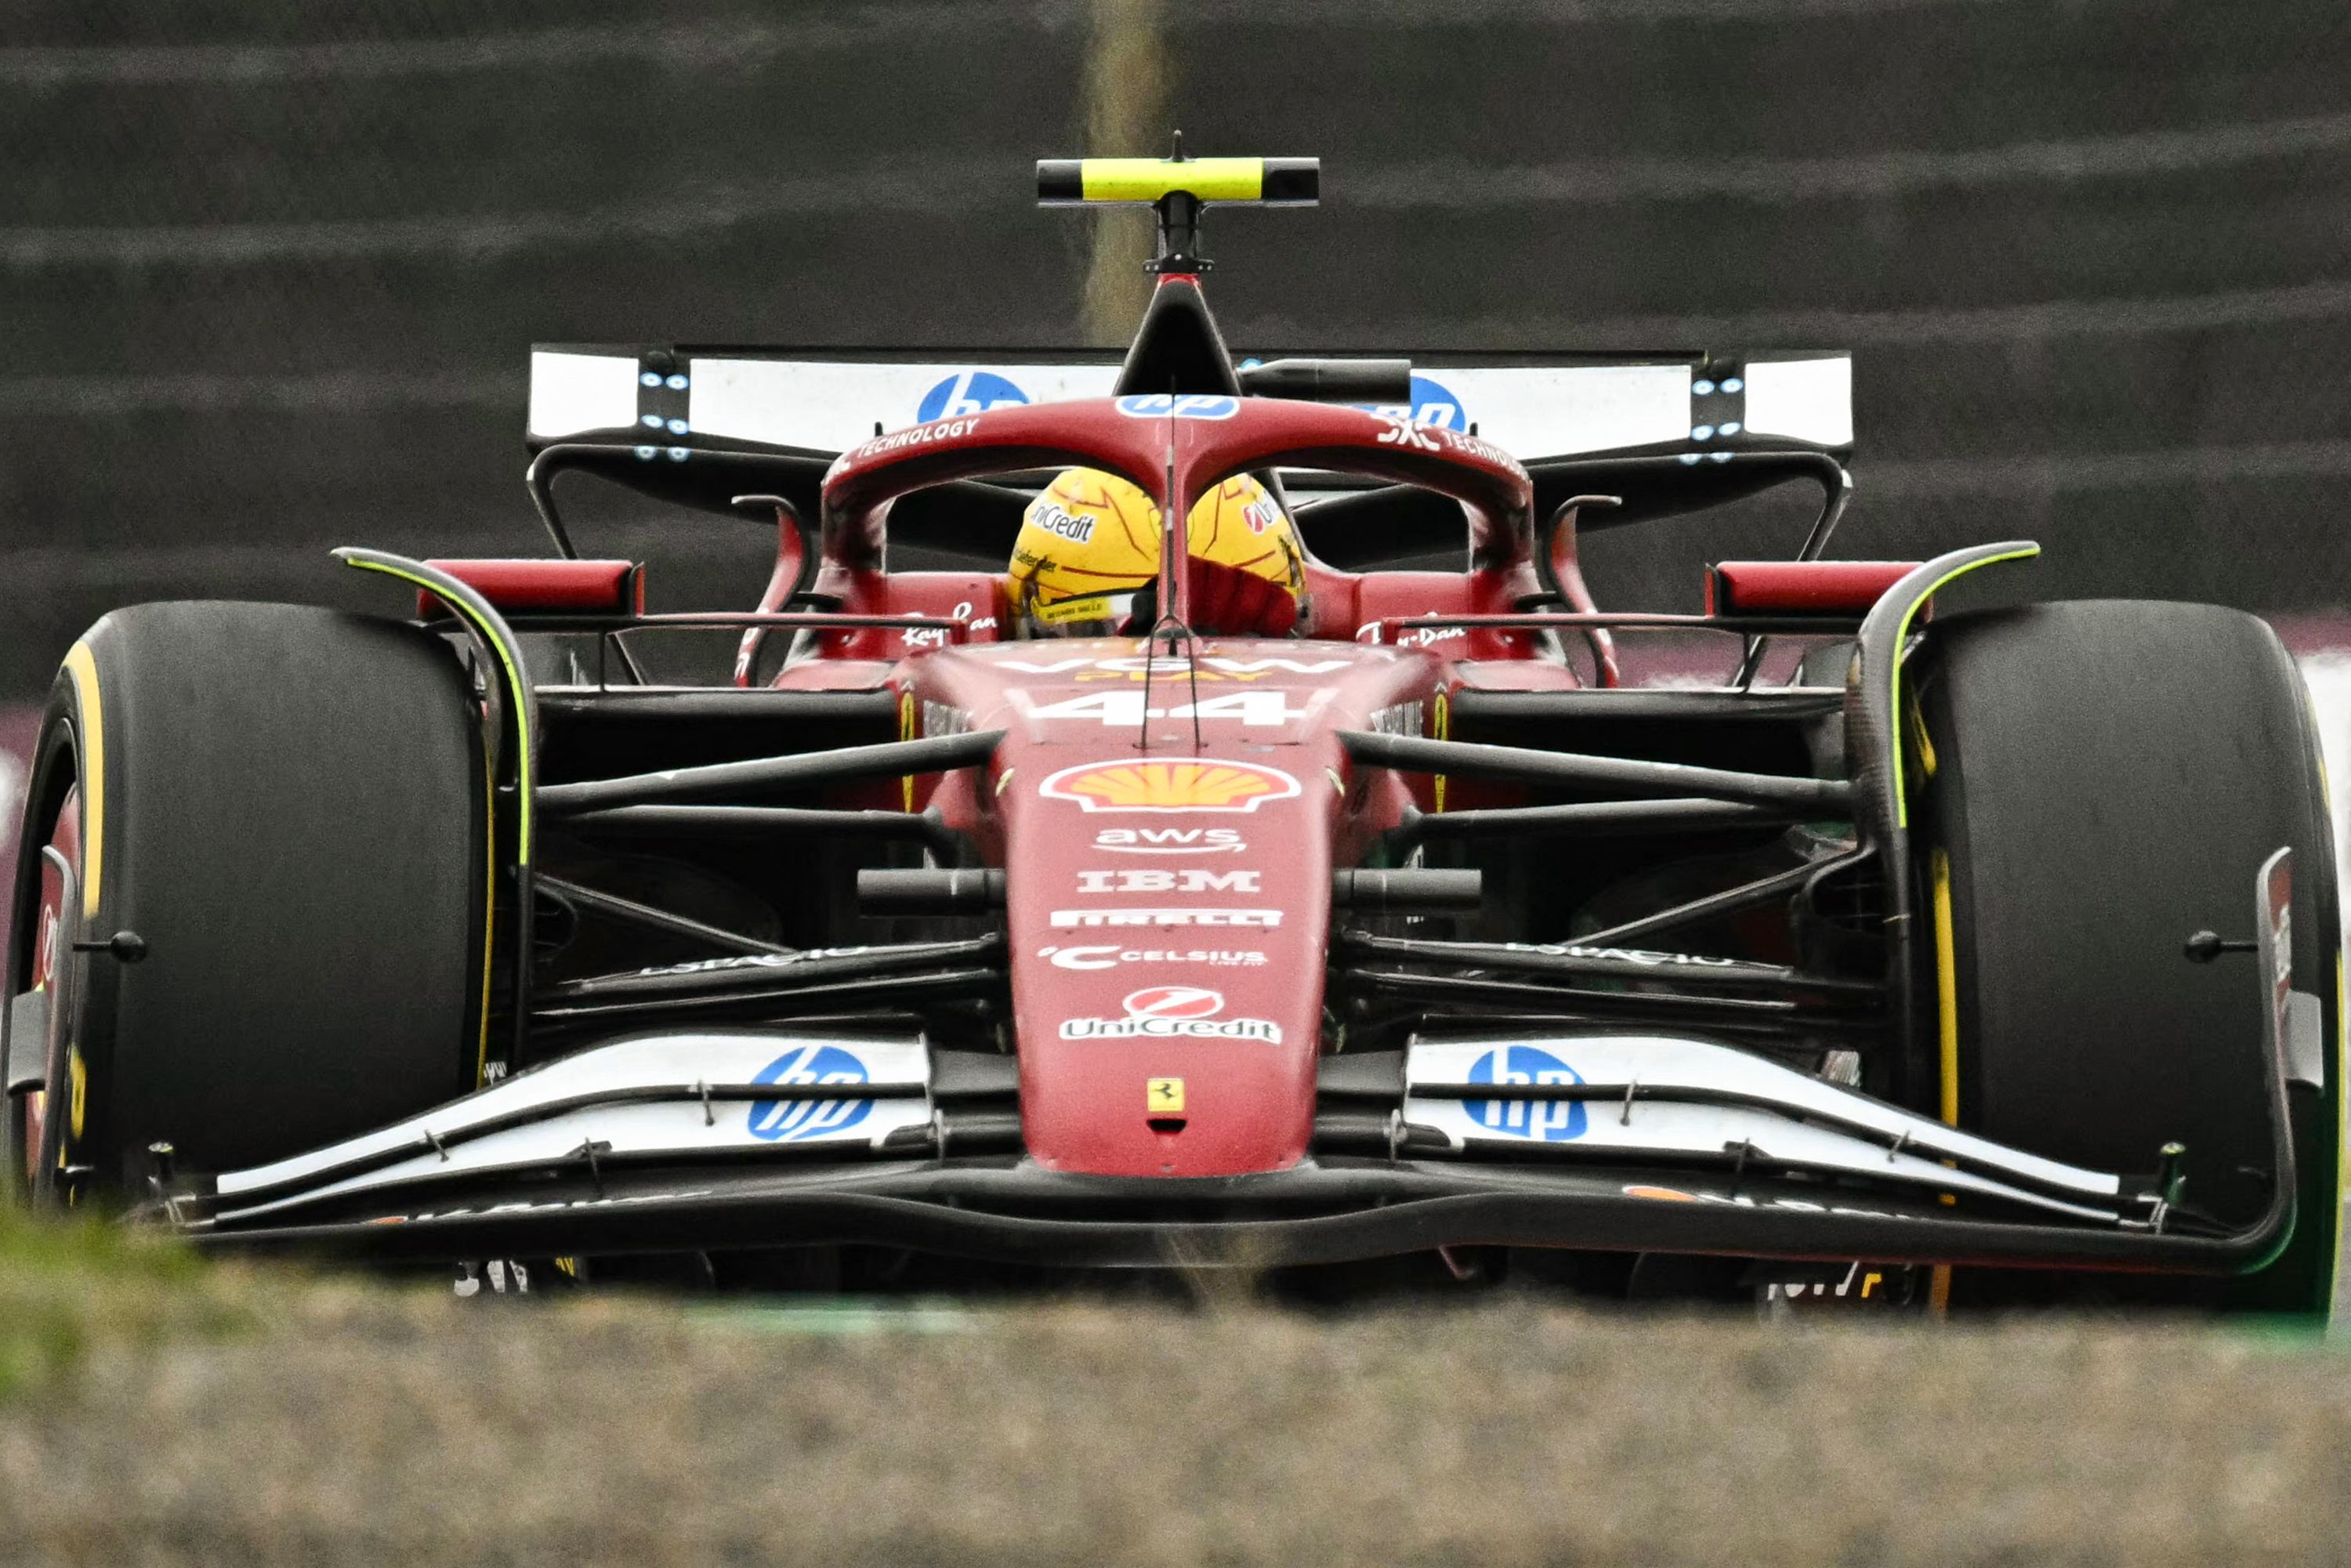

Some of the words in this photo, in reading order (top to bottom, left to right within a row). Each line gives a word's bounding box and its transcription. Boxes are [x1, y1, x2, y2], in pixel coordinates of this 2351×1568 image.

[857, 418, 979, 459] TECHNOLOGY
[1031, 505, 1095, 542] niCredit
[994, 657, 1353, 675] VGW
[1074, 670, 1272, 683] PLAY
[1026, 690, 1307, 726] 44
[1096, 827, 1243, 844] aws
[1076, 869, 1261, 893] IBM
[1119, 950, 1269, 962] CELSIUS
[1065, 1018, 1278, 1040] UniCredit
[756, 1045, 864, 1140] hp
[1483, 1045, 1575, 1141] hp
